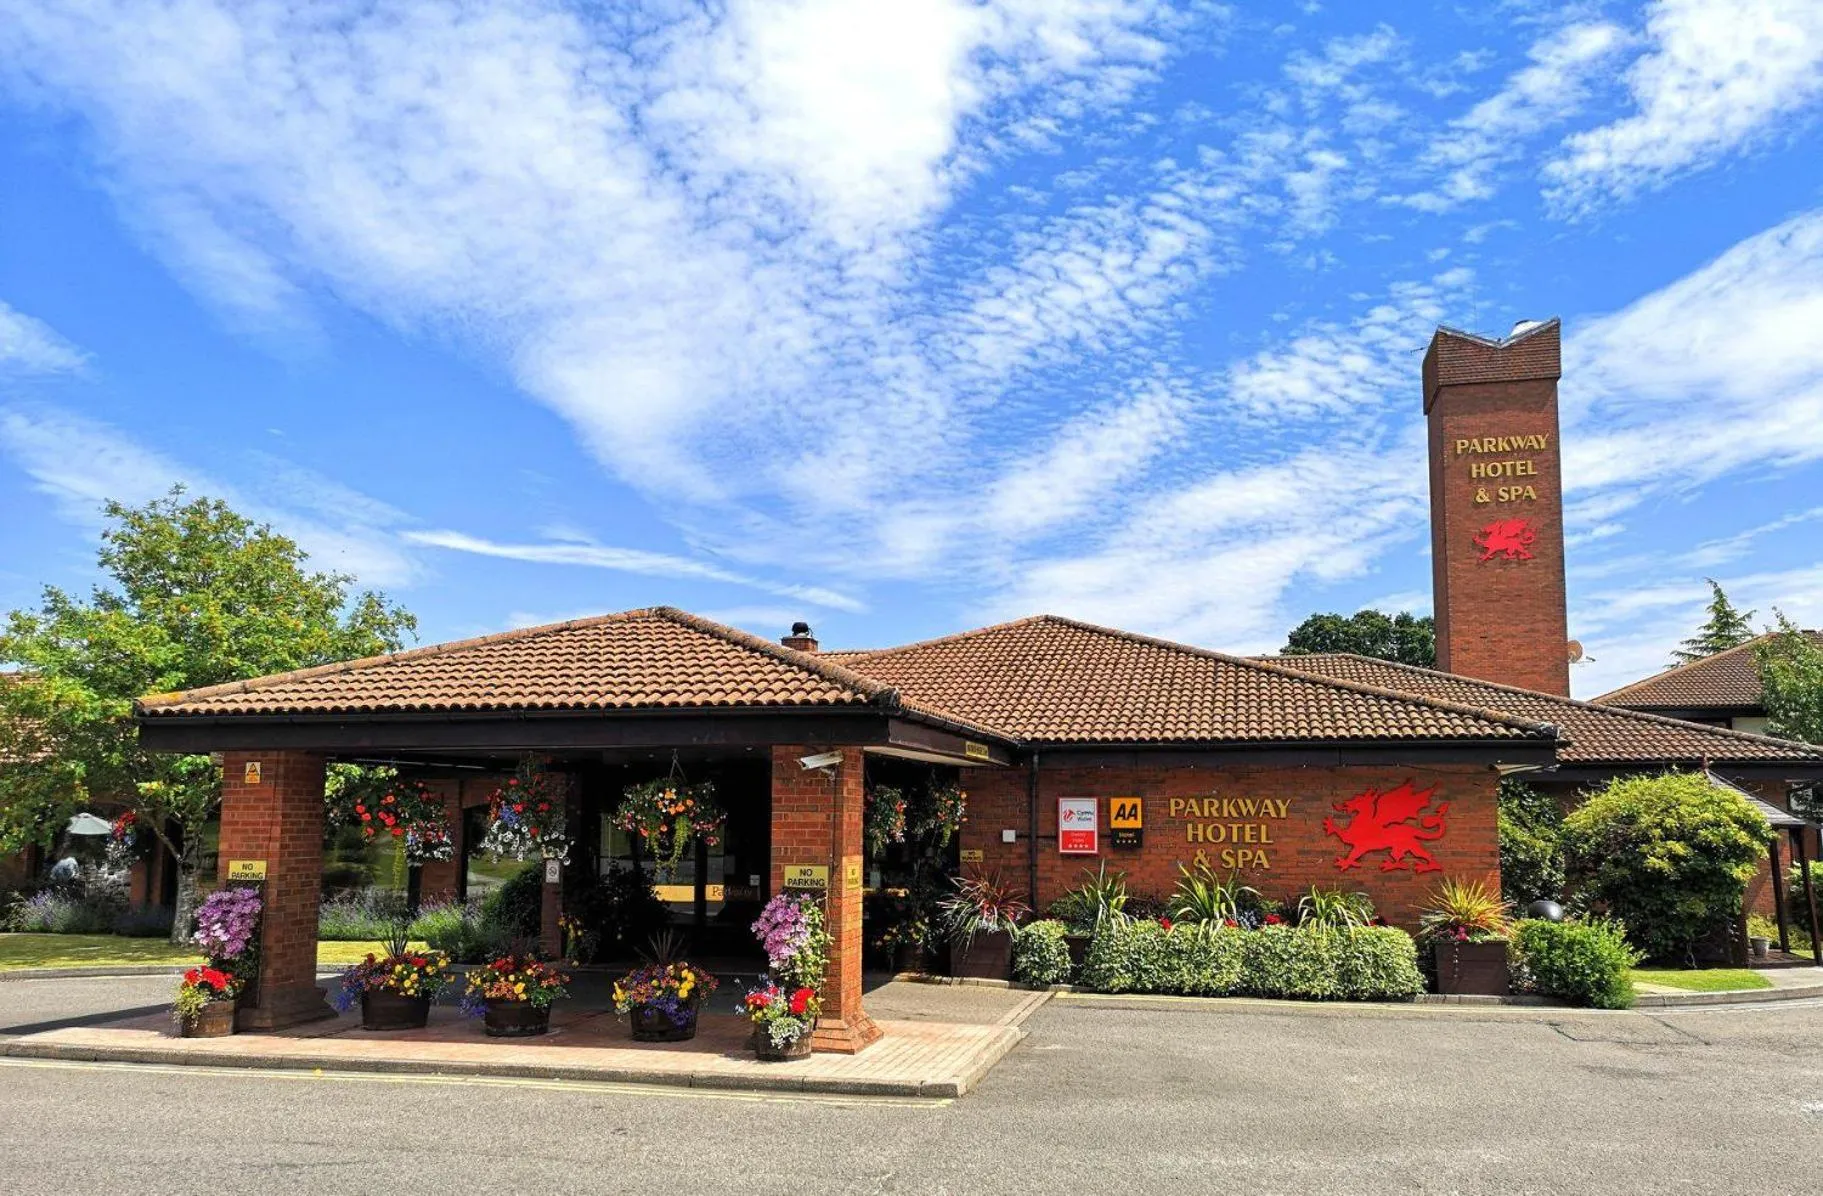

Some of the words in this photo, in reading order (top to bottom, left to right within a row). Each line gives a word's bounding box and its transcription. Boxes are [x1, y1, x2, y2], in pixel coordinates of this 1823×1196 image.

[1456, 433, 1549, 454] PARKWAY
[1471, 460, 1538, 478] HOTEL
[1475, 487, 1490, 503] &
[1498, 485, 1537, 502] SPA
[1114, 802, 1138, 821] AA
[1169, 798, 1291, 819] PARKWAY
[1186, 823, 1274, 843] HOTEL
[242, 863, 254, 871] NO
[1193, 848, 1211, 869] &
[1221, 848, 1271, 869] SPA
[231, 871, 264, 880] PARKING
[800, 868, 813, 877] NO
[787, 878, 825, 887] PARKING
